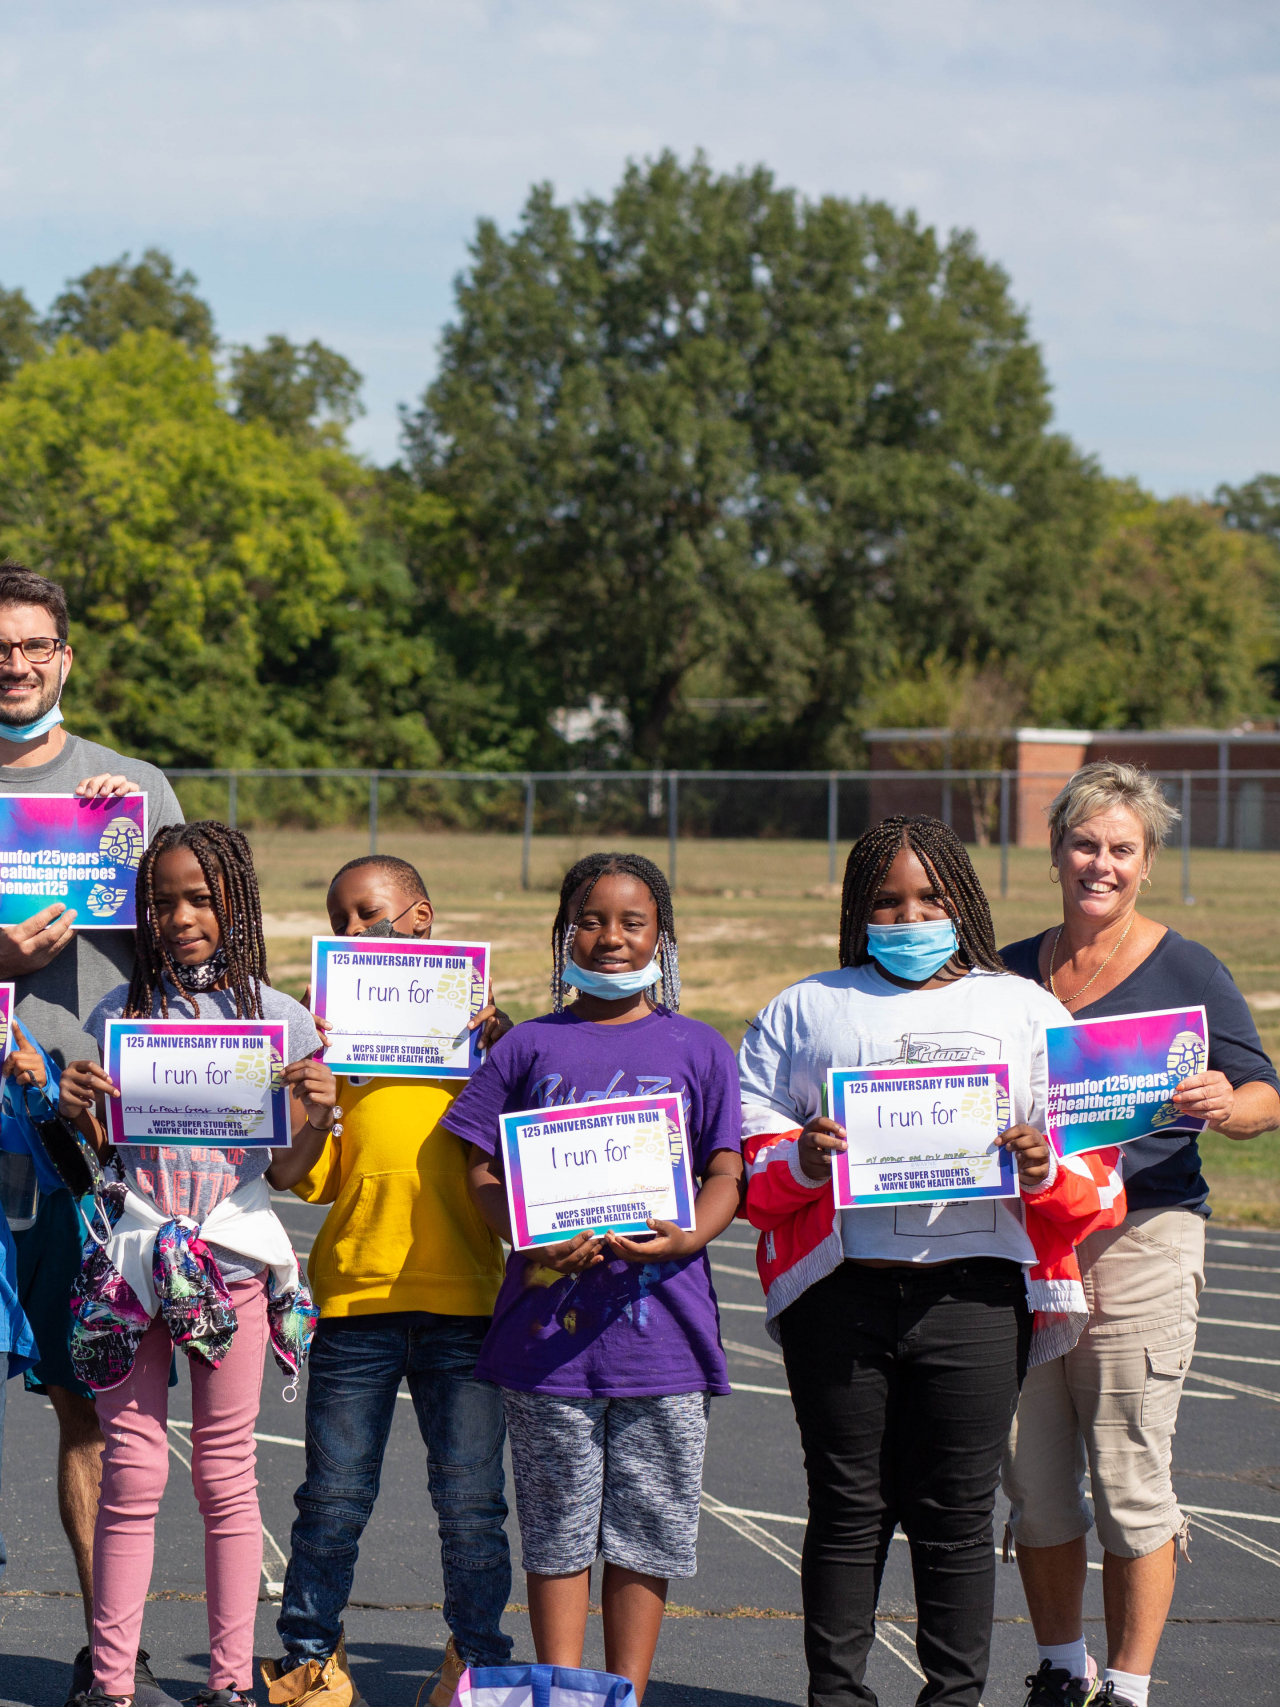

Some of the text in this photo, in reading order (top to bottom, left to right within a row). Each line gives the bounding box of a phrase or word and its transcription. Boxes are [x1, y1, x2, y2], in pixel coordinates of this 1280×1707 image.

[333, 954, 465, 969] 125 ANNIVERSARY FUN RUN
[357, 979, 433, 1003] I run for
[126, 1037, 263, 1049] 125 ANNIVERSARY FUN RUN
[376, 1045, 399, 1053] SUPER
[401, 1046, 439, 1055] STUDENTS
[397, 1055, 423, 1063] HEALTH
[425, 1056, 444, 1064] CARE
[153, 1062, 232, 1084] I run for
[849, 1076, 989, 1093] 125 ANNIVERSARY FUN RUN
[1048, 1072, 1168, 1098] #runfor125years
[878, 1102, 957, 1128] I run for
[1047, 1106, 1135, 1129] #thenext125
[203, 1121, 242, 1129] STUDENTS
[522, 1112, 659, 1138] 125 ANNIVERSARY FUN RUN
[552, 1139, 631, 1169] I run for
[879, 1168, 969, 1181] WCPS SUPER STUDENTS
[882, 1182, 908, 1190] WAYNE
[909, 1181, 926, 1189] UNC
[927, 1178, 955, 1188] HEALTH
[957, 1177, 976, 1185] CARE
[556, 1202, 646, 1220] WCPS SUPER STUDENTS
[558, 1219, 585, 1228] WAYNE
[586, 1217, 603, 1226] UNC
[604, 1214, 631, 1224] HEALTH
[633, 1211, 652, 1220] CARE
